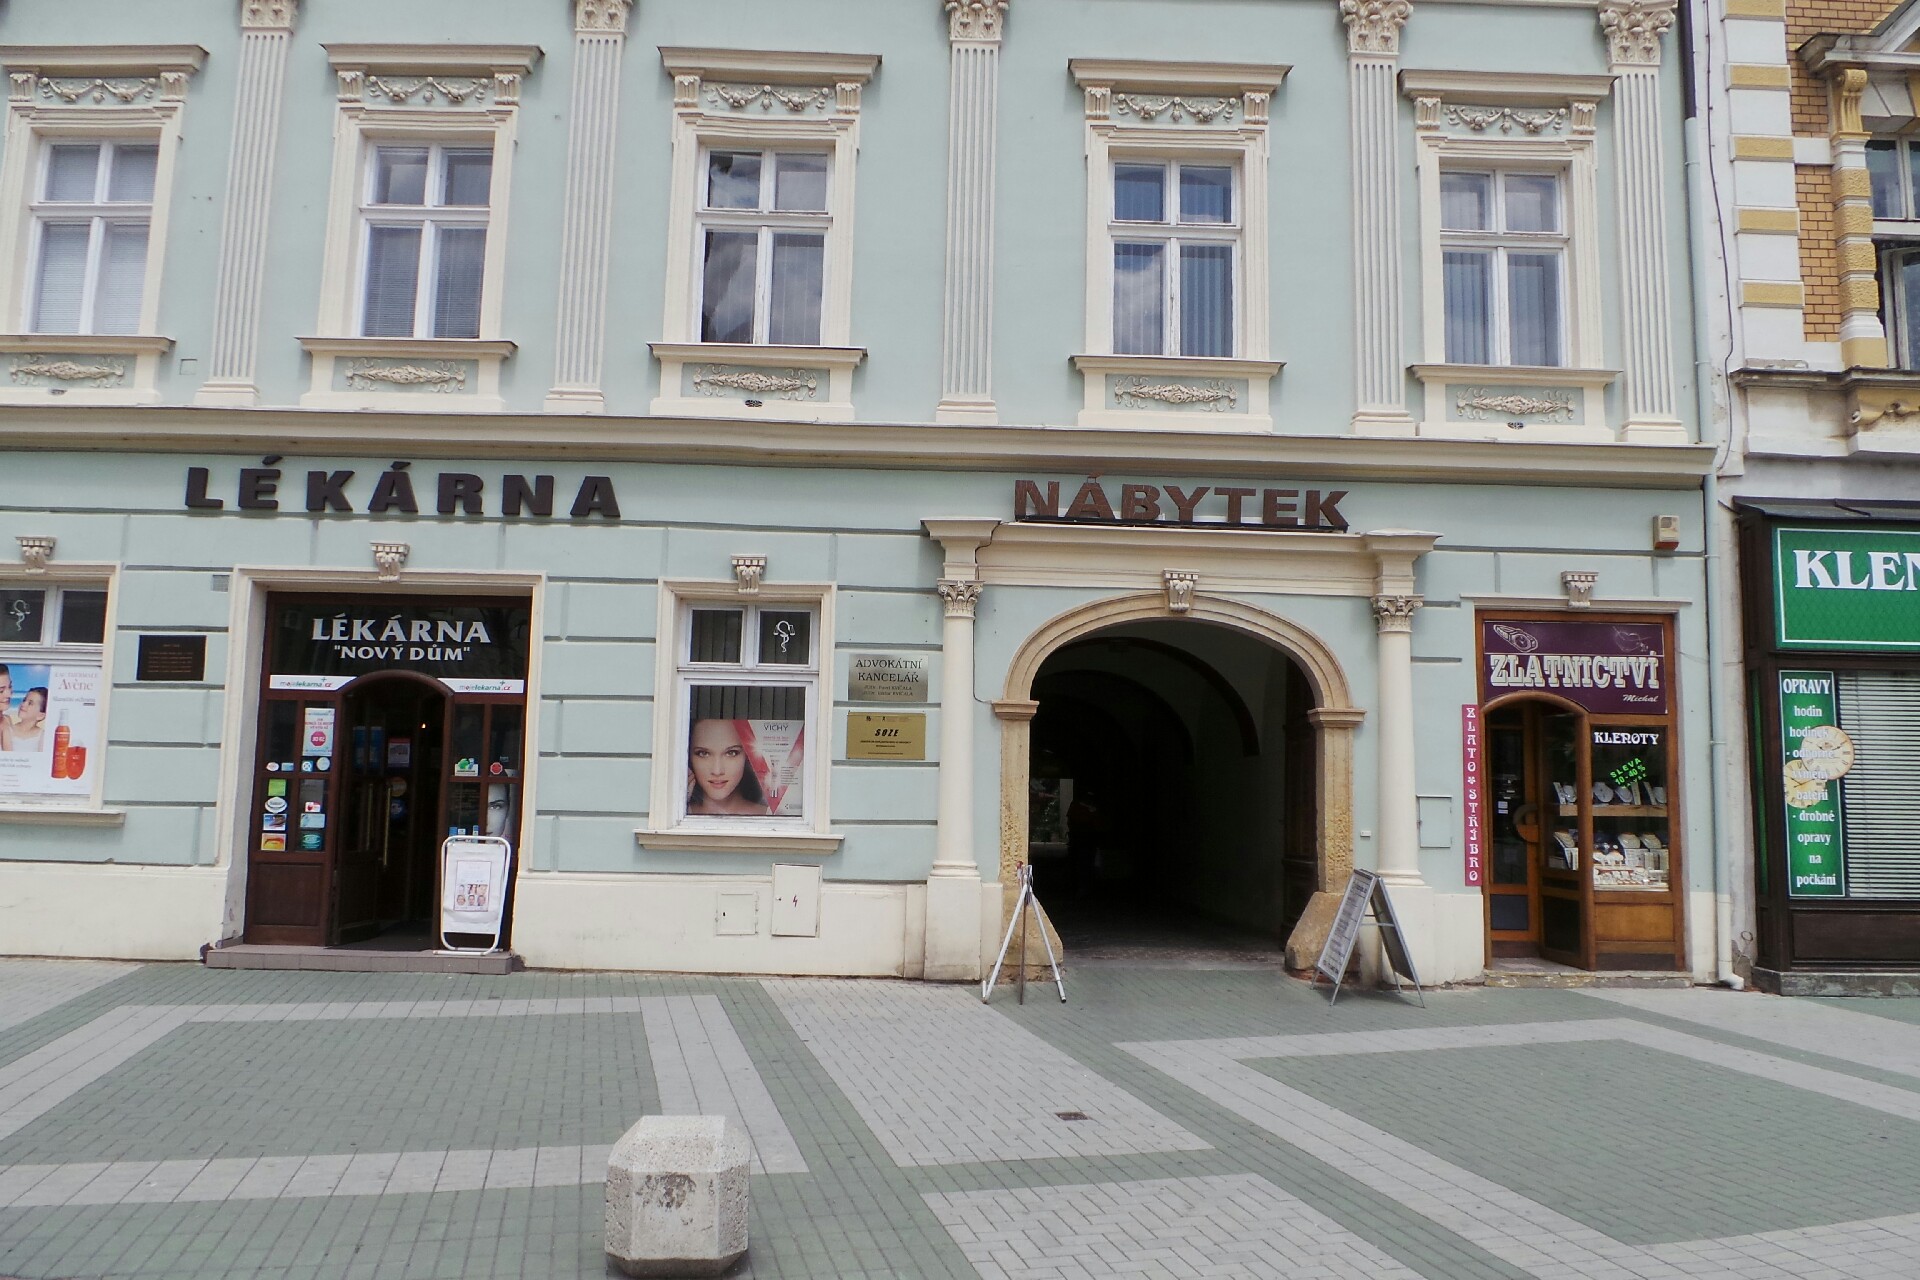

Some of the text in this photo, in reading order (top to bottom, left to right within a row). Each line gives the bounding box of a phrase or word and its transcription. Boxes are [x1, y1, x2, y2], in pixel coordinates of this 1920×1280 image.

[185, 454, 621, 518] LÉKÁRNA
[1014, 472, 1350, 529] NÁBYTEK
[311, 613, 492, 643] LÉKÁRNA
[334, 644, 471, 661] "NOVÝ DŮM"
[855, 658, 922, 669] ADVOKÁTNÍ
[1489, 651, 1660, 689] ZLATNICTVÍ
[858, 671, 919, 683] KANCELÁŘ
[58, 678, 94, 690] Avène
[1783, 678, 1830, 694] OPRAVY
[1622, 694, 1658, 703] Michal
[1794, 705, 1823, 717] hodin
[764, 724, 789, 732] VICHY
[875, 728, 899, 737] SOZE
[1594, 731, 1659, 745] KLENOTY
[1610, 758, 1642, 778] SLEVA
[1466, 707, 1479, 881] ZLATO STŘÍBRO
[1799, 810, 1835, 821] drobné
[1797, 833, 1832, 846] opravy
[1809, 854, 1823, 864] na
[1796, 873, 1837, 888] počkání
